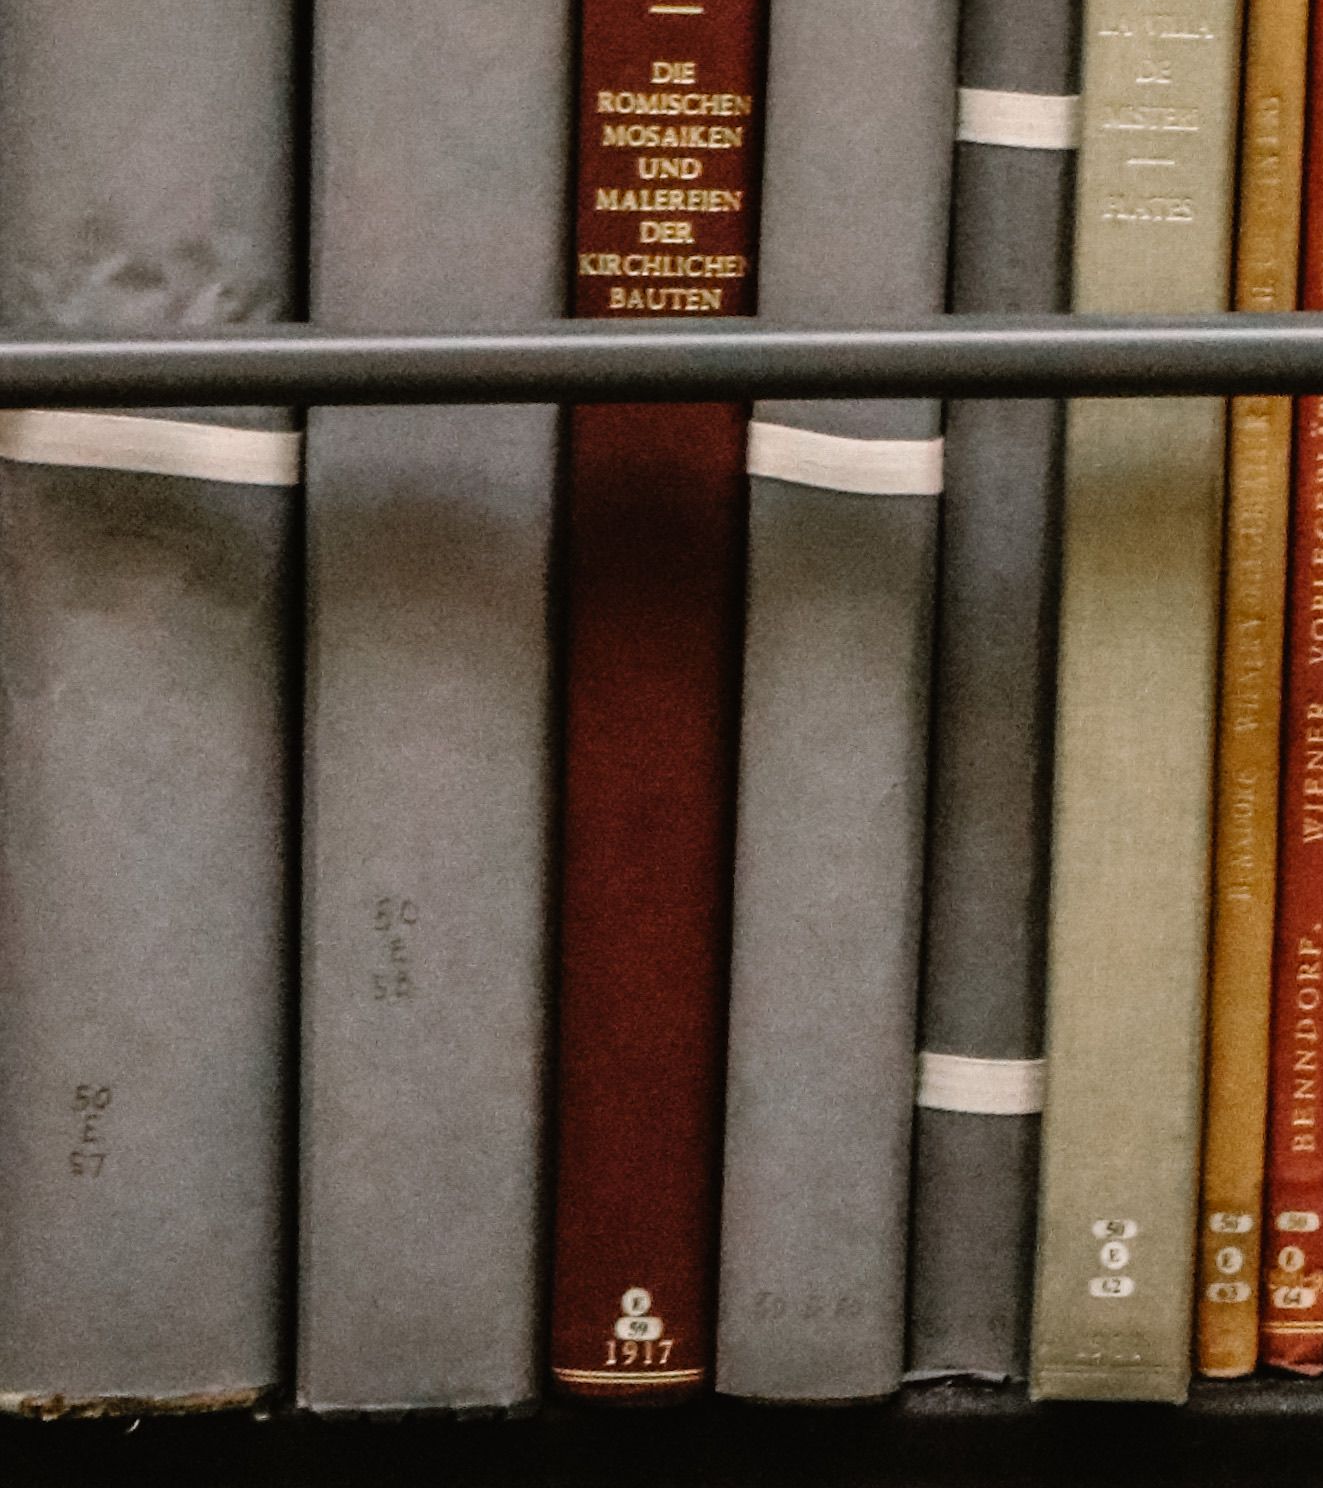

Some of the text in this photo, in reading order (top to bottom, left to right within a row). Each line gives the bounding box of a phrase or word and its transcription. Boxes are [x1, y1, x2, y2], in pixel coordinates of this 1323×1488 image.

[651, 62, 695, 85] DIE
[602, 125, 743, 149] MOSAIKEN
[638, 157, 701, 180] UND
[595, 189, 742, 212] MALEREIEN
[639, 221, 694, 243] DER
[610, 288, 722, 310] BAUTEN
[1293, 922, 1323, 1154] BENNDORF.
[606, 1341, 675, 1365] 1917
